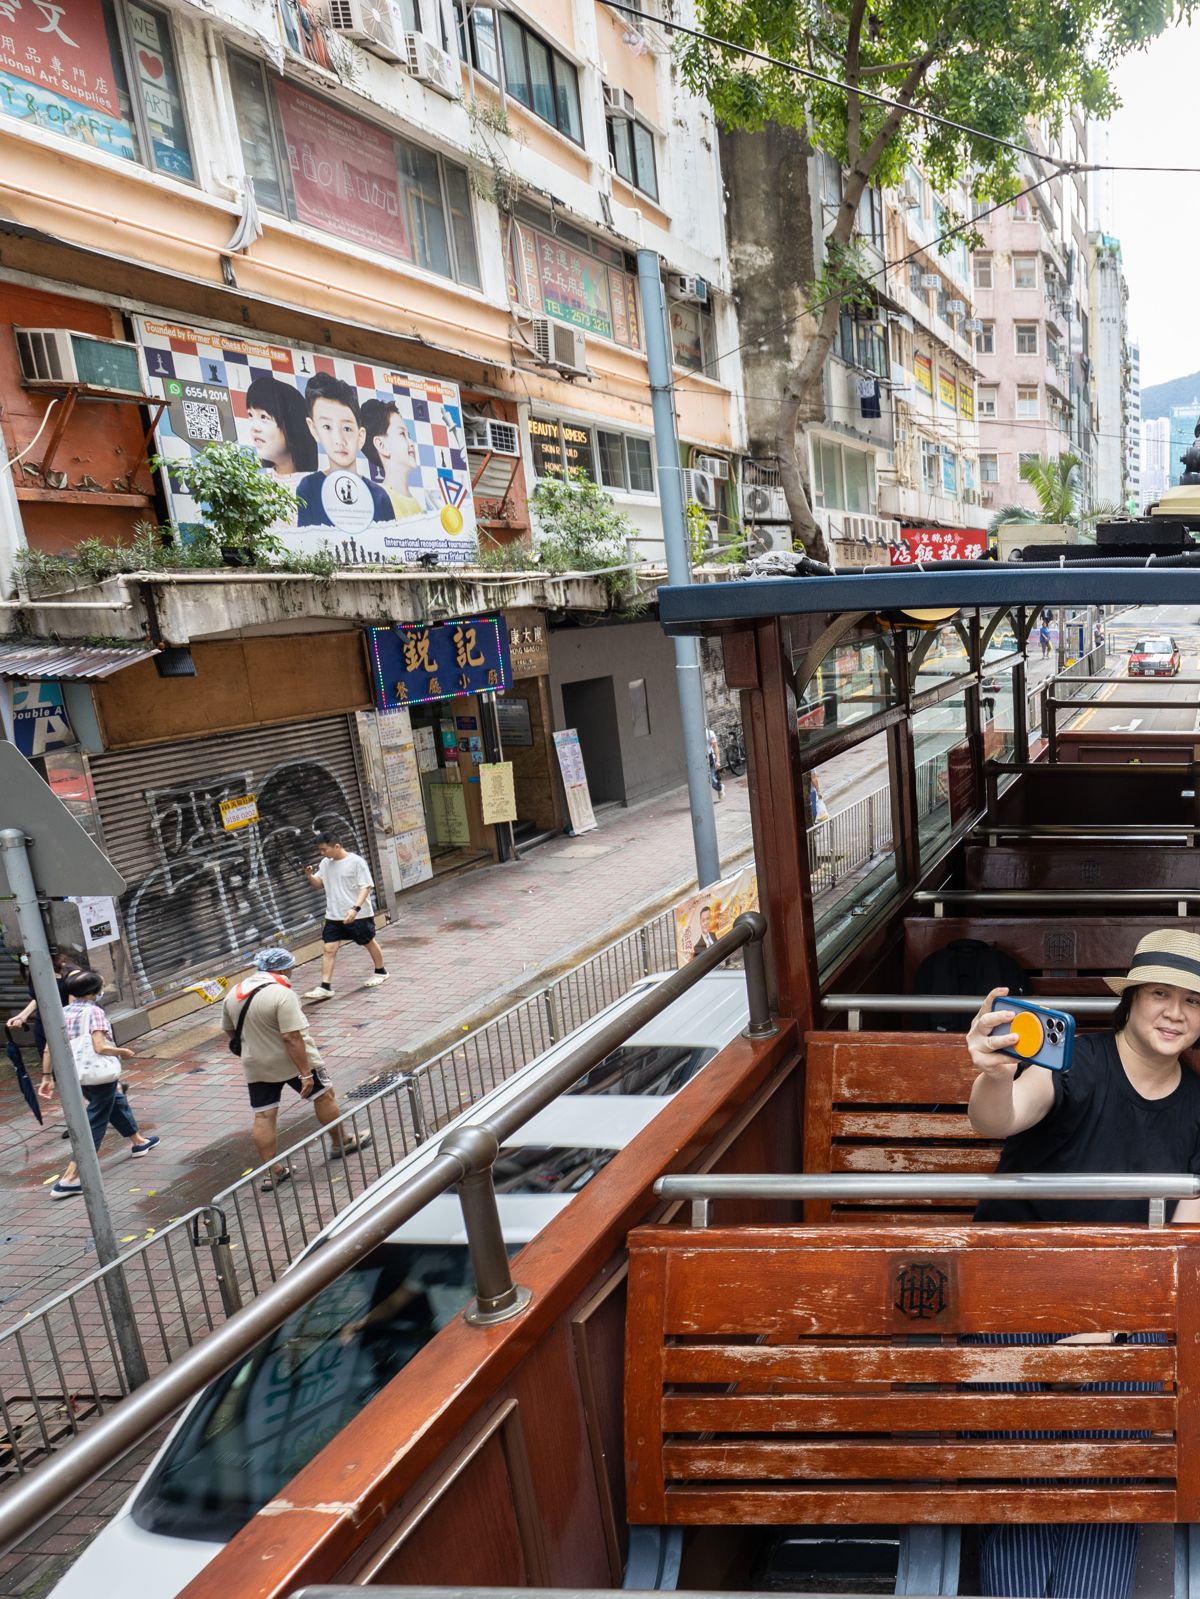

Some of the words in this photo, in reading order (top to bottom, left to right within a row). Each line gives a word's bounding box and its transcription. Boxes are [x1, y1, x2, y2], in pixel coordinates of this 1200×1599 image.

[132, 14, 158, 41] WE
[39, 70, 59, 87] Art
[62, 80, 112, 110] Supplies
[143, 90, 172, 120] ART
[545, 298, 565, 317] TEL
[185, 386, 207, 399] 6554
[208, 390, 228, 402] 2014
[54, 706, 63, 715] A
